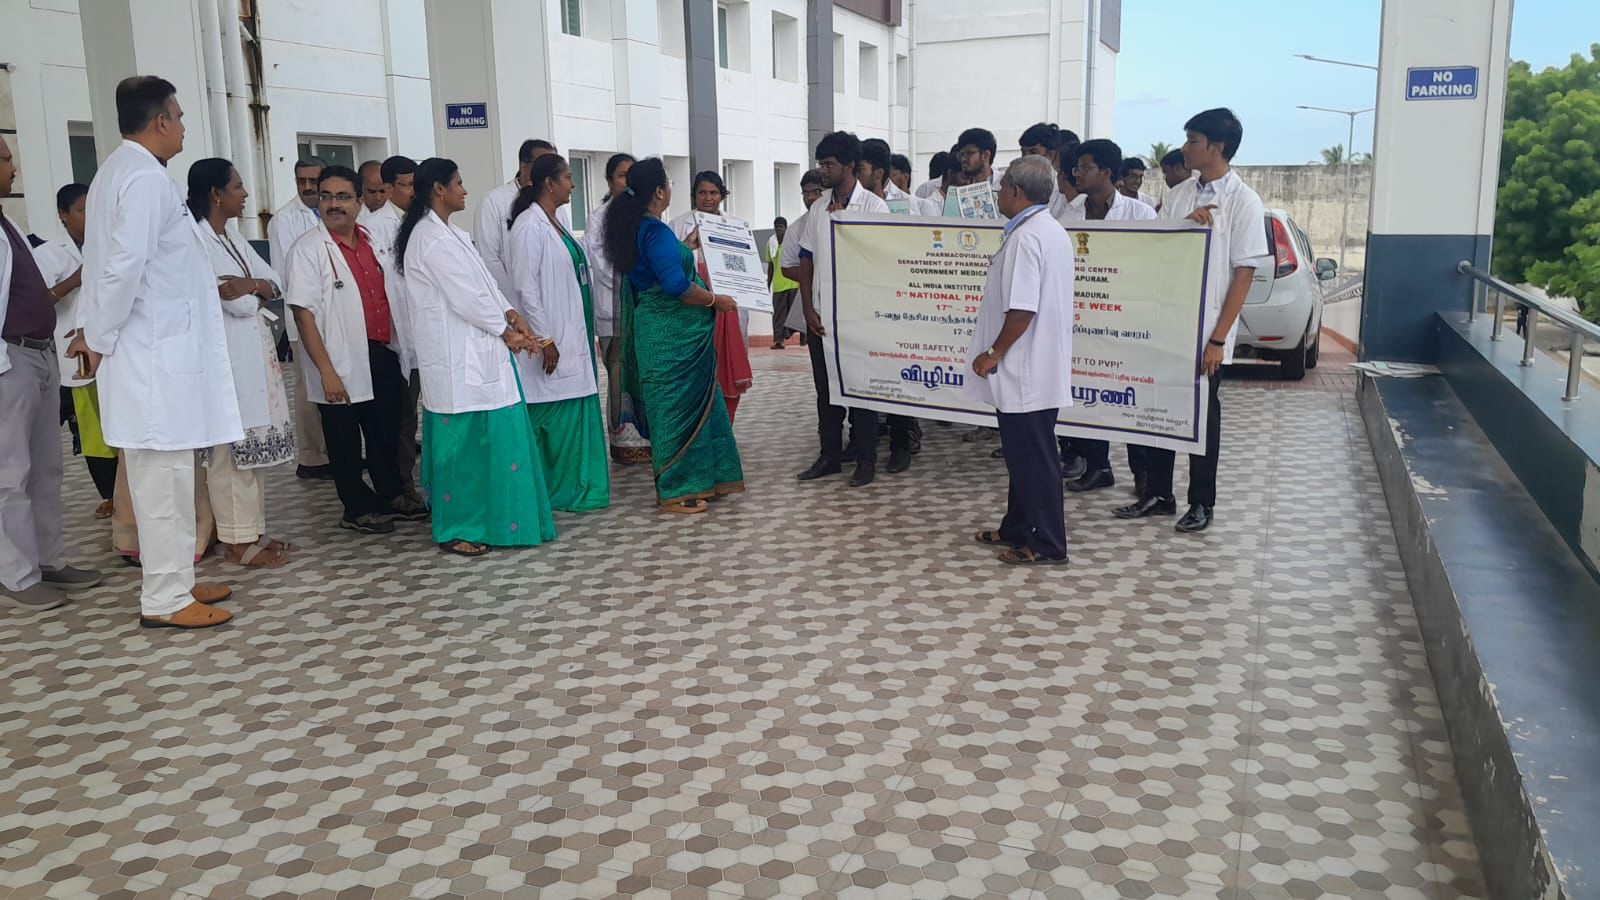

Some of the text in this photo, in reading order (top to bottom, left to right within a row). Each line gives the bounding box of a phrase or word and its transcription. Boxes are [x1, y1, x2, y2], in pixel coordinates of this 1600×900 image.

[1433, 71, 1453, 82] NO
[1412, 84, 1472, 96] PARKING
[460, 106, 473, 115] NO
[450, 117, 485, 126] PARKING
[926, 252, 994, 260] PHARMACOVIGILAN
[1074, 275, 1109, 283] APURAM,
[944, 283, 982, 291] INSTITUTE
[909, 292, 961, 301] NATIONAL
[1090, 303, 1122, 312] WEEK
[953, 328, 975, 336] 17-2
[895, 342, 920, 350] "YOUR
[922, 344, 955, 353] SAFETY,
[1084, 358, 1096, 366] TO
